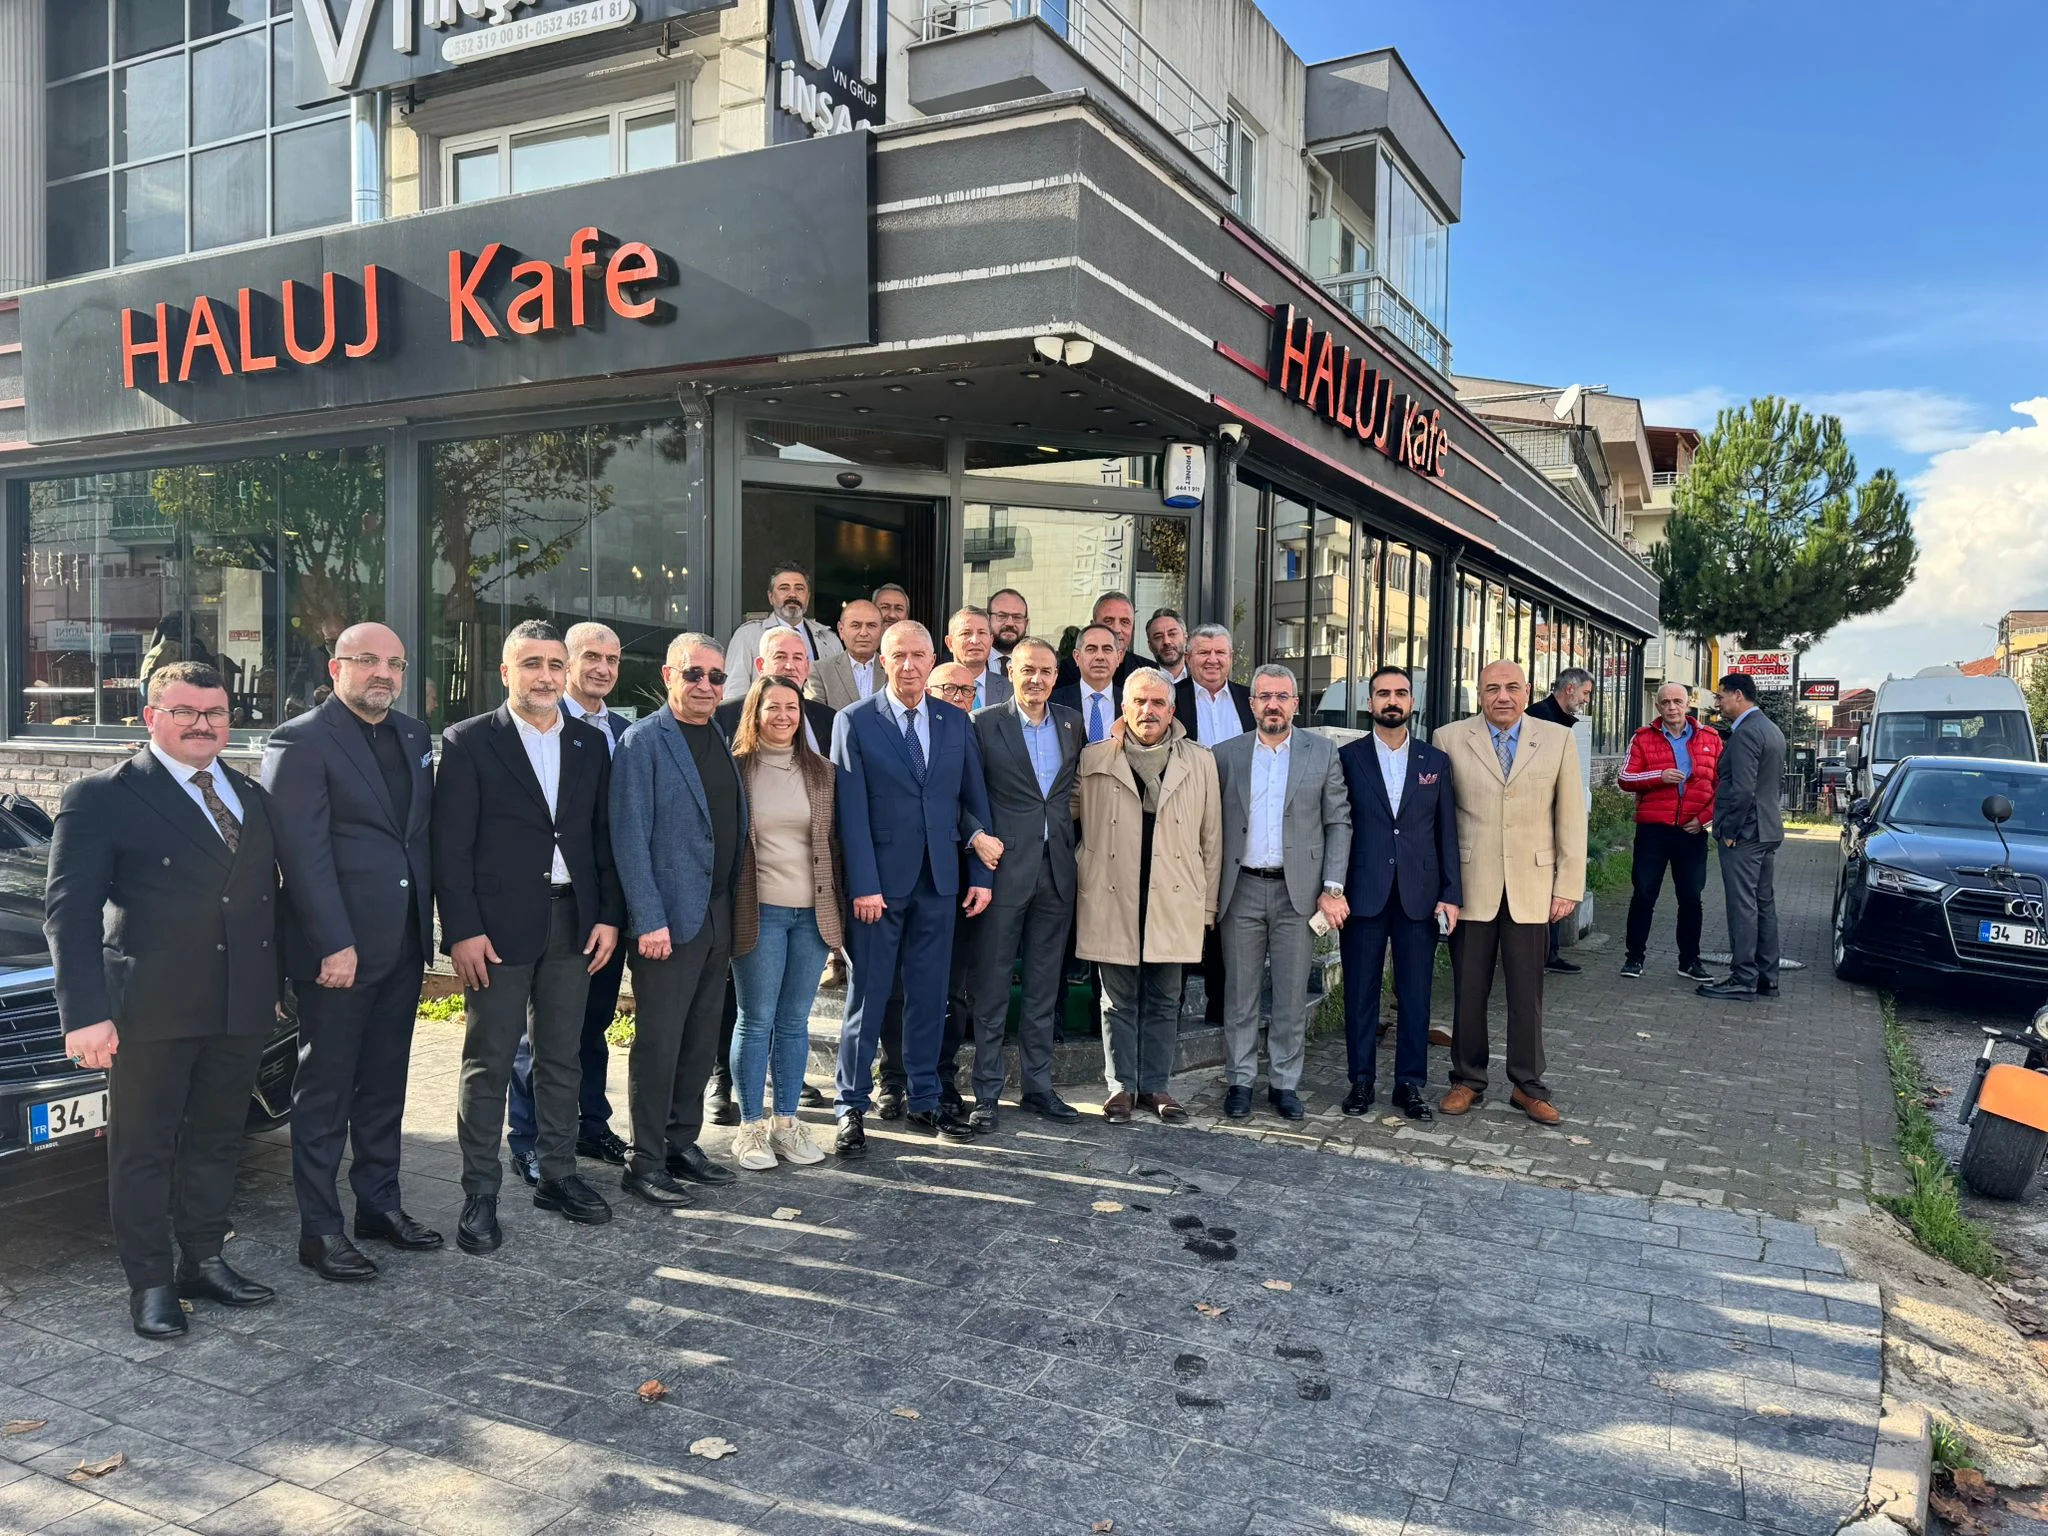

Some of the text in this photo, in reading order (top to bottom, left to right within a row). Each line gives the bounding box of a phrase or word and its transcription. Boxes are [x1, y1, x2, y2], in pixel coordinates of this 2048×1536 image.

[476, 32, 497, 50] 319
[499, 27, 514, 45] 00
[566, 9, 588, 28] 452
[591, 5, 605, 22] 41
[609, 1, 623, 17] 81
[832, 65, 877, 108] VN GRUP
[121, 226, 659, 389] HALUJ Kafe
[1280, 302, 1448, 478] HALUJ Kafe
[1738, 654, 1780, 664] ASLAN
[1991, 925, 2010, 942] 34
[33, 1124, 48, 1135] TR
[50, 1100, 85, 1134] 34
